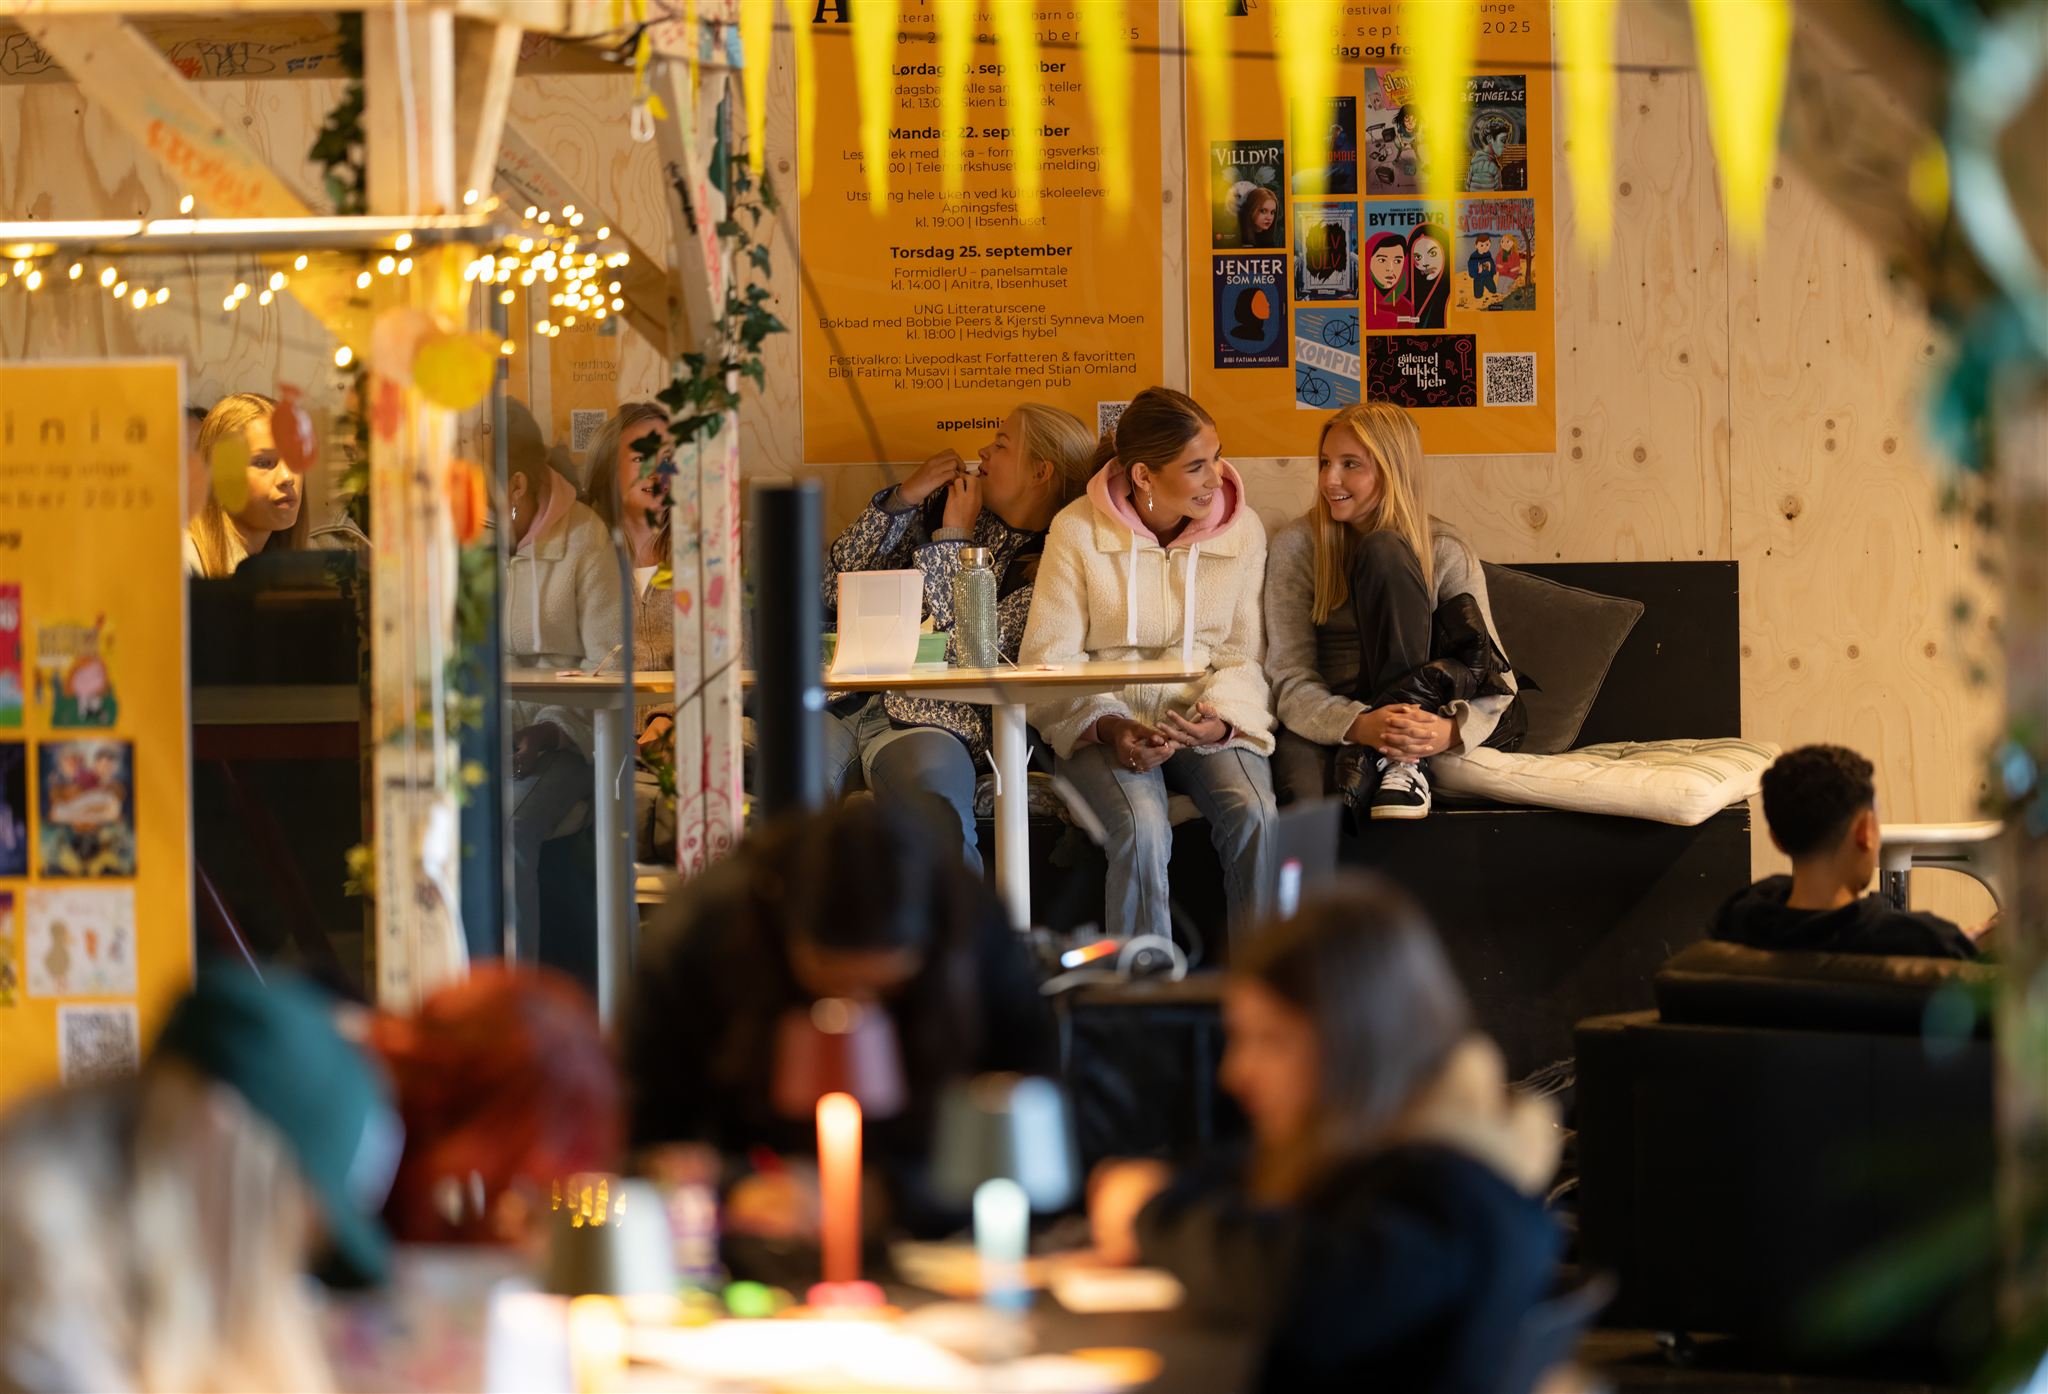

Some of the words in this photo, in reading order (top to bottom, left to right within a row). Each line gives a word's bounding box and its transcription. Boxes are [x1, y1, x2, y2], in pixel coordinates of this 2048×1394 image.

[1480, 3, 1515, 14] unge
[1483, 21, 1531, 34] 2025
[1364, 46, 1386, 59] og
[892, 62, 945, 77] Lørdag
[1050, 81, 1082, 92] teller
[1461, 90, 1525, 102] BETINGELSE
[901, 98, 915, 109] kl.
[959, 126, 979, 138] 22.
[910, 148, 939, 159] med
[1215, 147, 1280, 166] VILLDYR
[908, 189, 935, 200] hele
[939, 188, 971, 200] uken
[975, 188, 997, 199] ved
[915, 217, 929, 228] kl.
[933, 216, 965, 228] 19:00
[975, 216, 1047, 227] Ibsenhuset
[1369, 212, 1444, 226] BYTTEDYR
[890, 246, 954, 260] Torsdag
[959, 245, 981, 258] 25.
[985, 244, 1073, 259] september
[1216, 260, 1283, 275] JENTER
[1311, 253, 1341, 270] ULV
[894, 266, 967, 278] FormidlerU
[981, 265, 1068, 278] panelsamtale
[891, 280, 904, 291] kl.
[951, 278, 993, 291] Anitra,
[996, 278, 1068, 290] Ibsenhuset
[1226, 275, 1250, 285] SOM
[1252, 275, 1276, 285] MEG
[914, 303, 944, 315] UNG
[947, 303, 1046, 315] Litteraturscene
[819, 317, 869, 329] Bokbad
[873, 317, 902, 328] med
[906, 316, 951, 328] Bobbie
[955, 315, 991, 327] Peers
[994, 315, 1003, 327] &
[1007, 314, 1047, 328] Kjersti
[1050, 314, 1104, 328] Synneva
[1108, 313, 1145, 325] Moen
[906, 328, 920, 340] kl.
[924, 328, 956, 340] 18:00
[966, 328, 1018, 341] Hedvigs
[1022, 327, 1057, 340] hybel
[829, 354, 901, 366] Festivalkro:
[905, 353, 982, 366] Livepodkast
[985, 352, 1058, 364] Forfatteren
[1061, 351, 1070, 363] &
[1073, 350, 1136, 362] favoritten
[1295, 340, 1360, 377] KOMPIS
[829, 367, 853, 378] Bibi
[857, 367, 902, 378] Fatima
[905, 366, 950, 377] Musavi
[960, 364, 1012, 376] samtale
[1015, 364, 1045, 375] med
[1048, 363, 1081, 375] Stian
[1084, 363, 1137, 374] Omland
[894, 379, 908, 390] kl.
[912, 378, 944, 390] 19:00
[954, 377, 1041, 390] Lundetangen
[1045, 375, 1071, 389] pub
[936, 416, 1004, 432] appelsini
